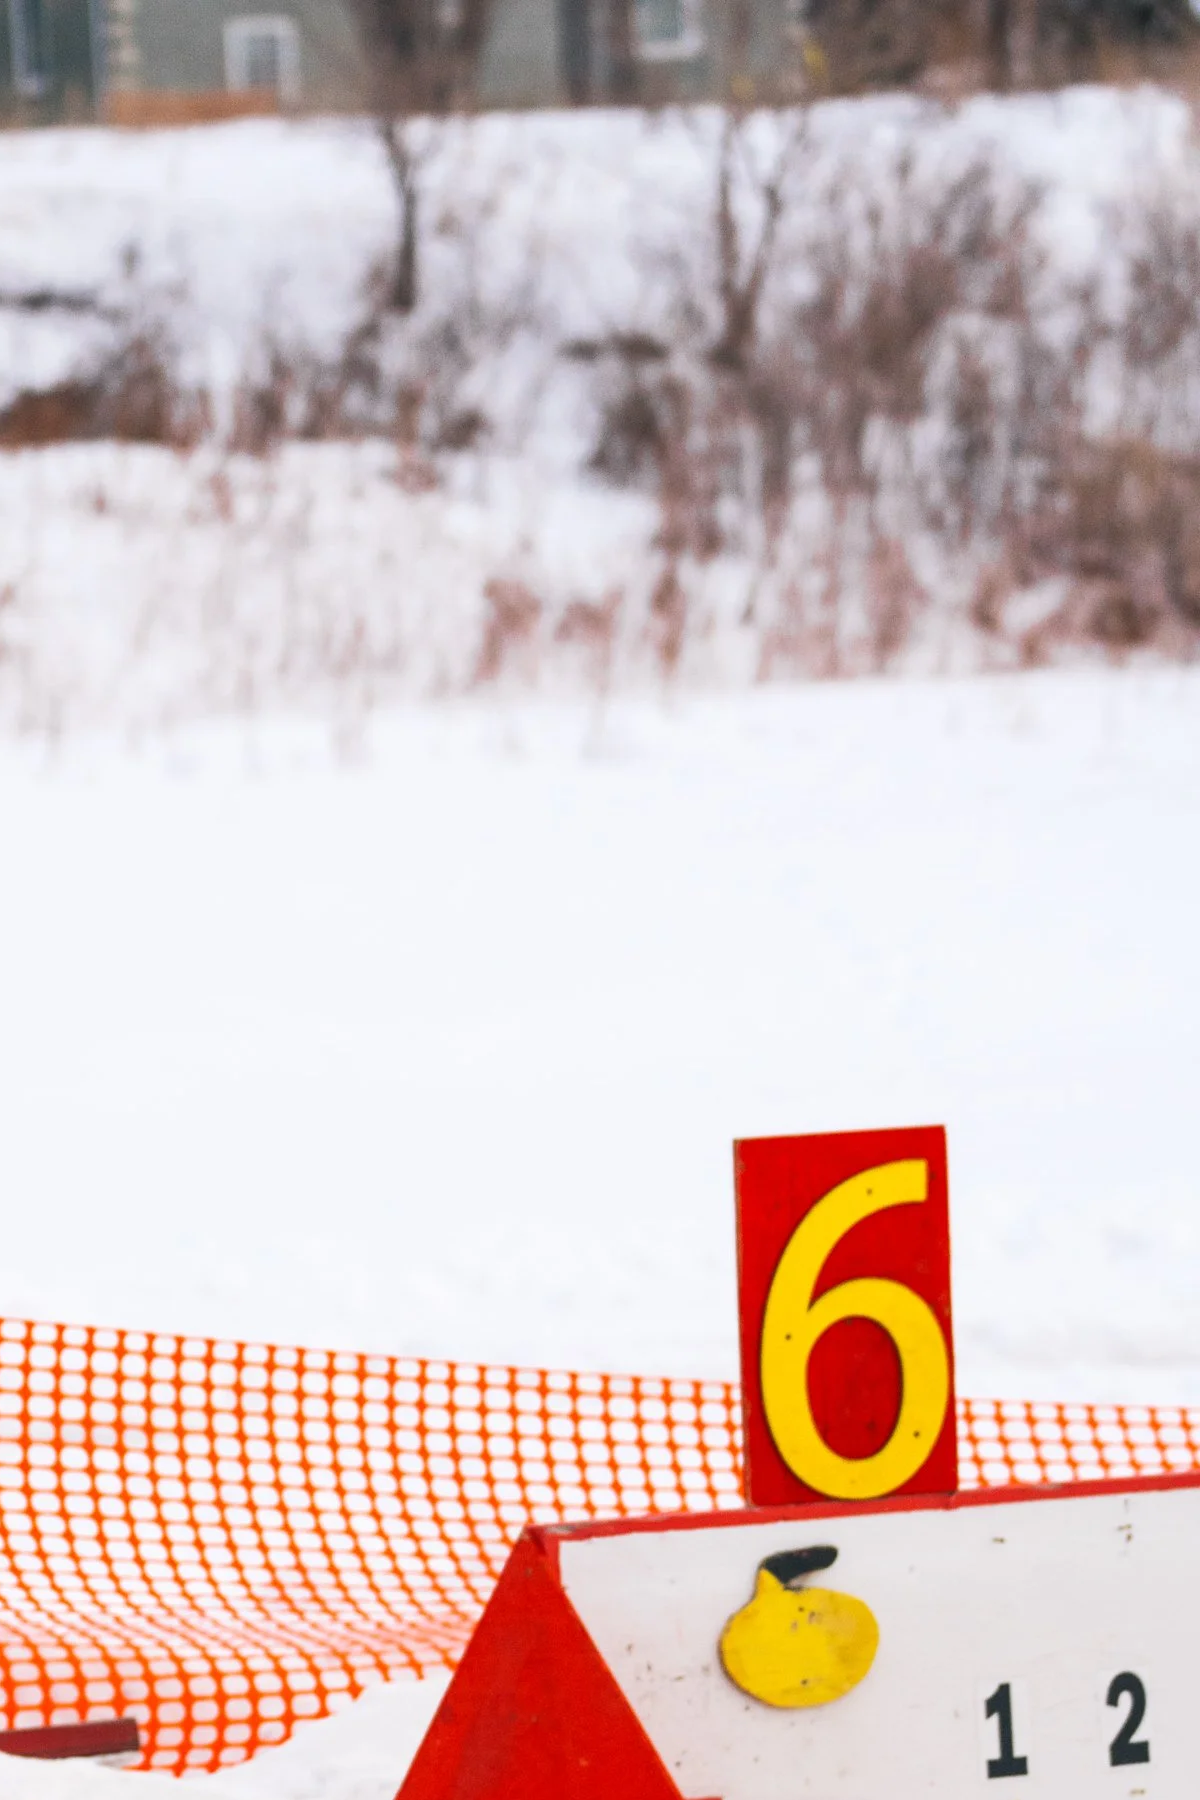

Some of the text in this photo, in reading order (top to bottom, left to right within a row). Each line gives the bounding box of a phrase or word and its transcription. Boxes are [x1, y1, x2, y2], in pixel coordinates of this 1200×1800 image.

[759, 1158, 949, 1500] 6
[984, 1670, 1151, 1778] 1 2
